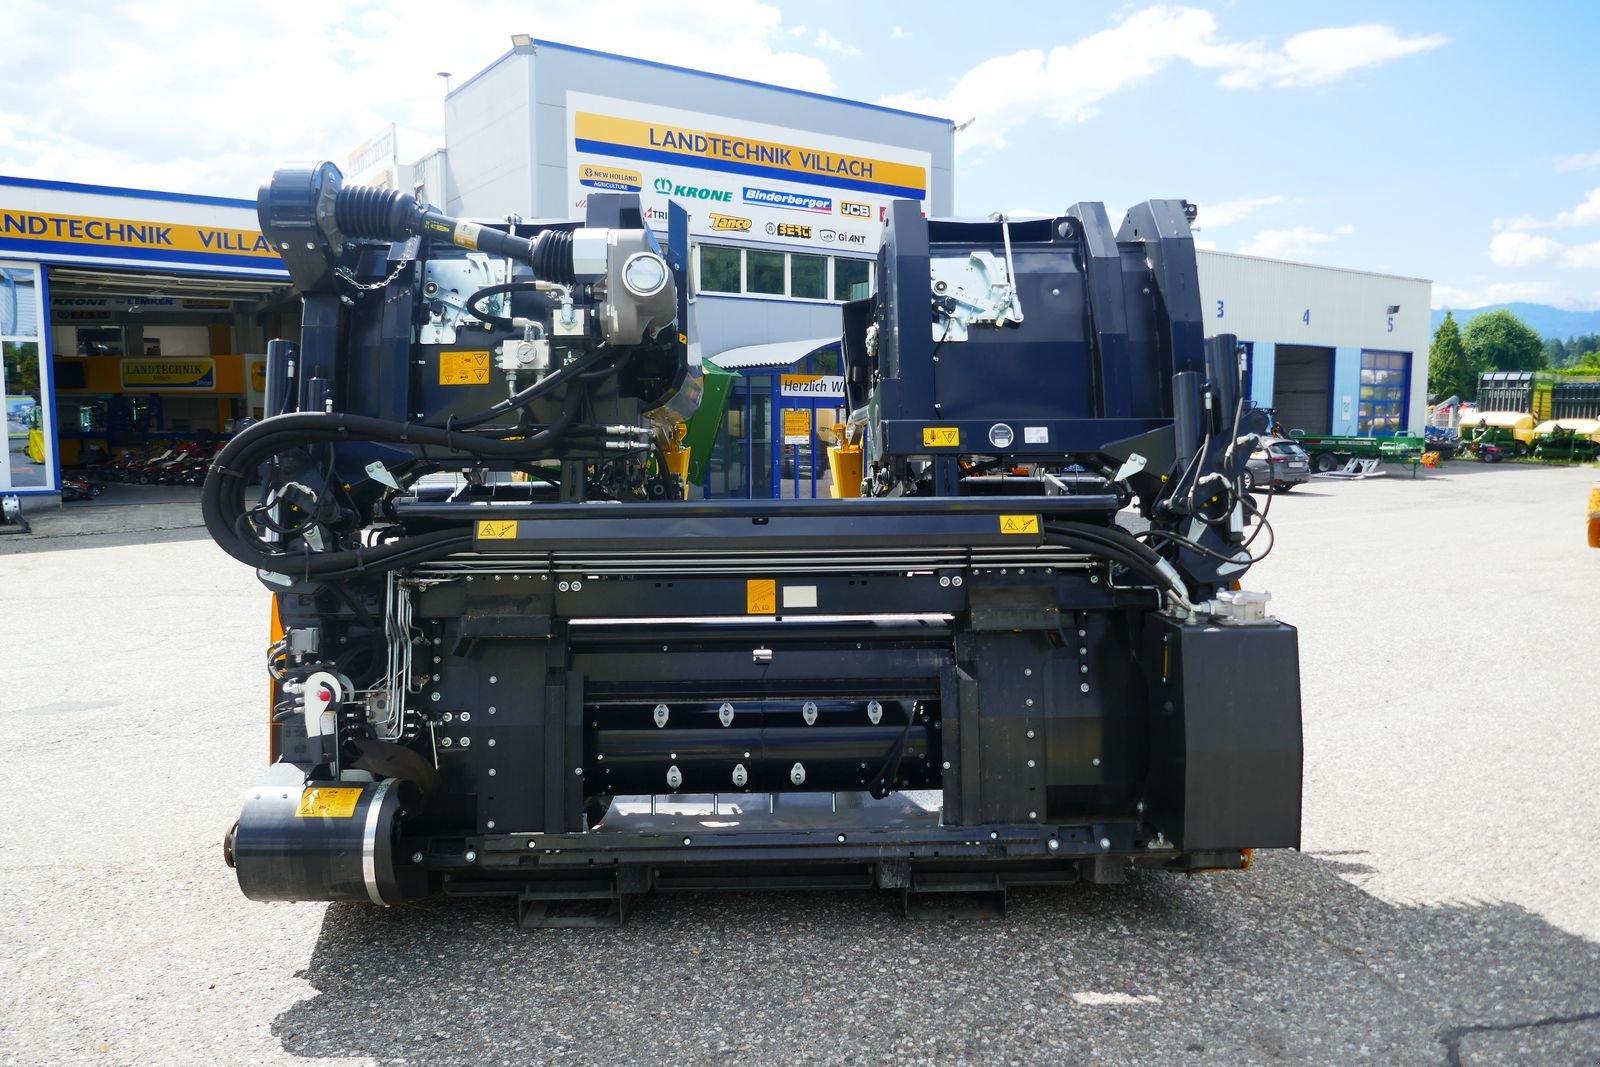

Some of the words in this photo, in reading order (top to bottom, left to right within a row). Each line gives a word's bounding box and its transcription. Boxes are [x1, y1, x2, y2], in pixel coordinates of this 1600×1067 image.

[649, 127, 792, 166] LANDTECHNIK
[799, 150, 873, 179] VILLACH
[609, 174, 637, 182] HOLLAND
[673, 184, 733, 203] KRONE
[745, 189, 831, 209] Binderberger
[841, 203, 870, 217] JCB
[0, 214, 173, 245] NDTECHNIK
[708, 213, 752, 232] Tanco
[1217, 300, 1224, 318] 3
[1302, 309, 1310, 326] 4
[1387, 317, 1394, 333] 5
[126, 364, 202, 374] LANDTECHNIK
[784, 380, 827, 393] Herzlich
